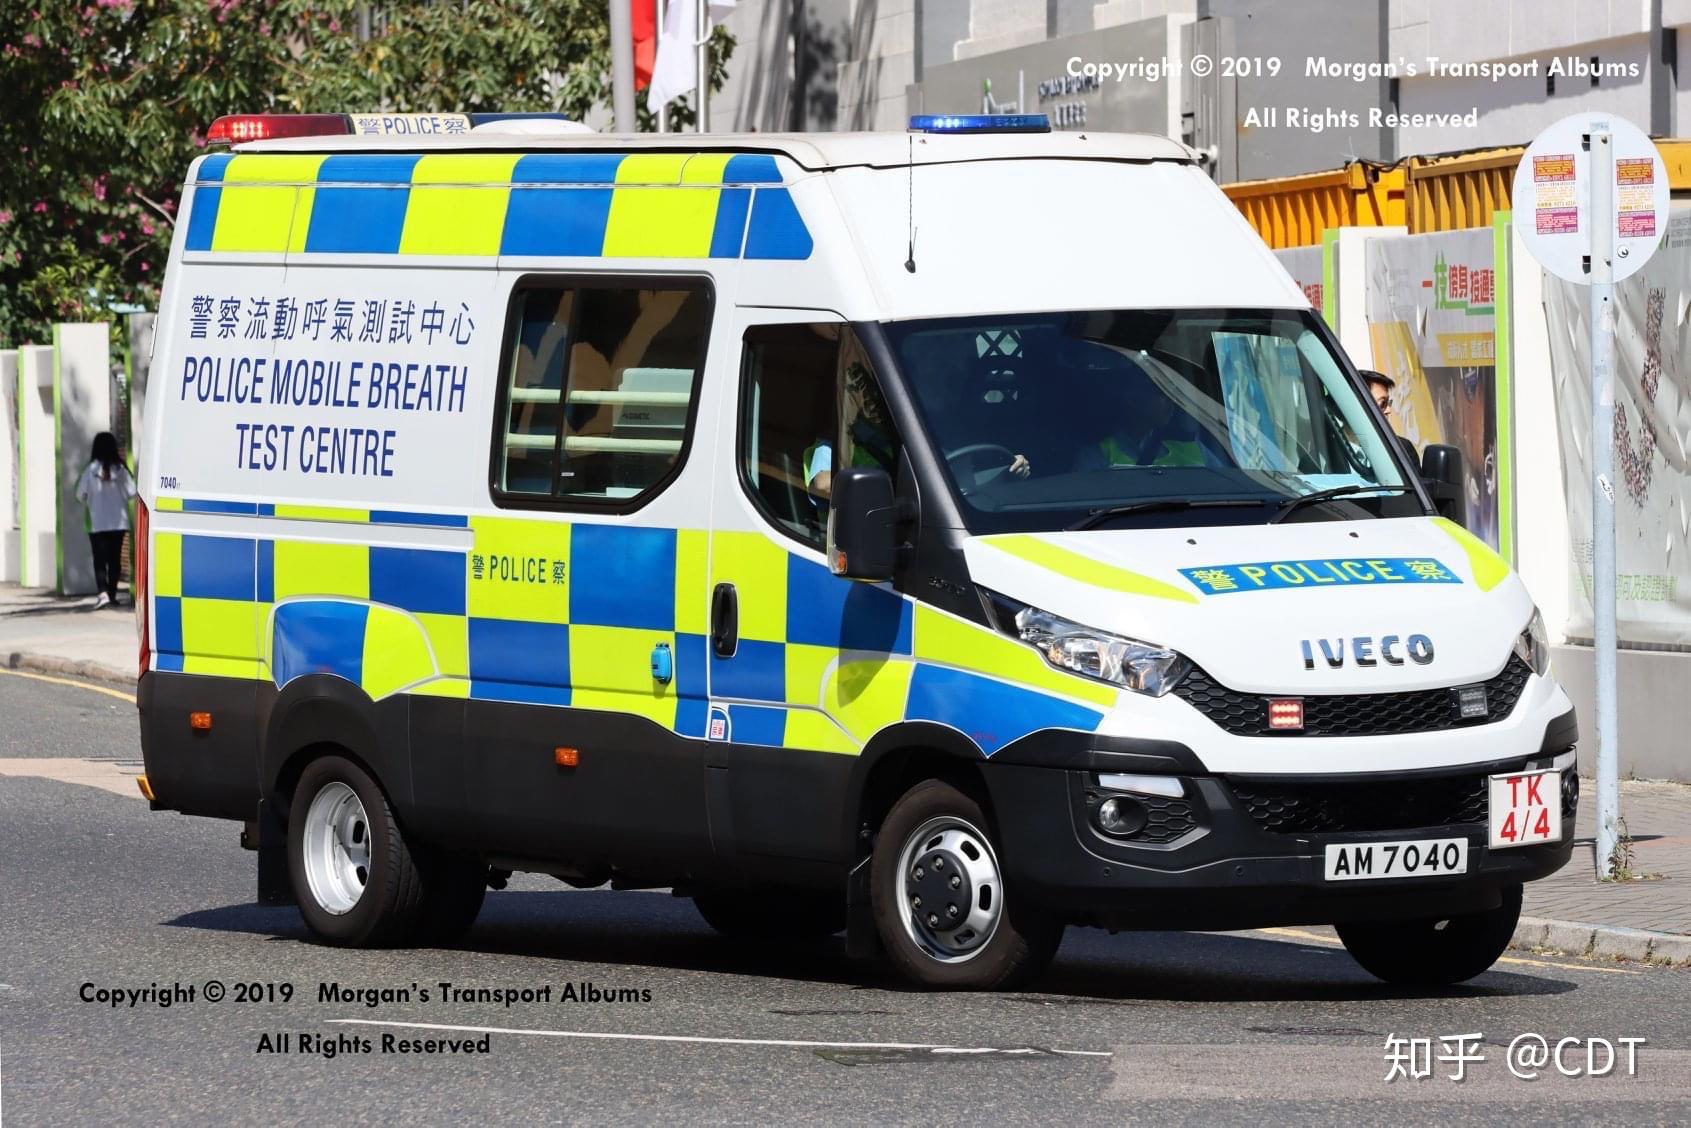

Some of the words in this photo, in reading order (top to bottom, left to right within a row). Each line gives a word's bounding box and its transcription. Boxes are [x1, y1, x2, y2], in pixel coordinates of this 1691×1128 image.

[189, 295, 475, 345] 警察流動呼氣測試中心
[181, 356, 266, 404] POLICE
[270, 359, 363, 408] MOBILE
[367, 362, 468, 412] BREATH
[236, 423, 294, 471] TEST
[299, 425, 396, 477] CENTRE
[160, 476, 177, 489] 7040
[472, 554, 484, 580] 警
[489, 555, 546, 583] POLICE
[552, 560, 565, 584] 察
[1190, 568, 1238, 591] 警
[1238, 560, 1405, 586] POLICE
[1403, 559, 1452, 580] 察
[1301, 633, 1435, 670] IVECO
[1506, 774, 1543, 808] TK
[1500, 807, 1550, 842] 4/4
[1334, 846, 1373, 876] AM
[1383, 842, 1460, 874] 7040
